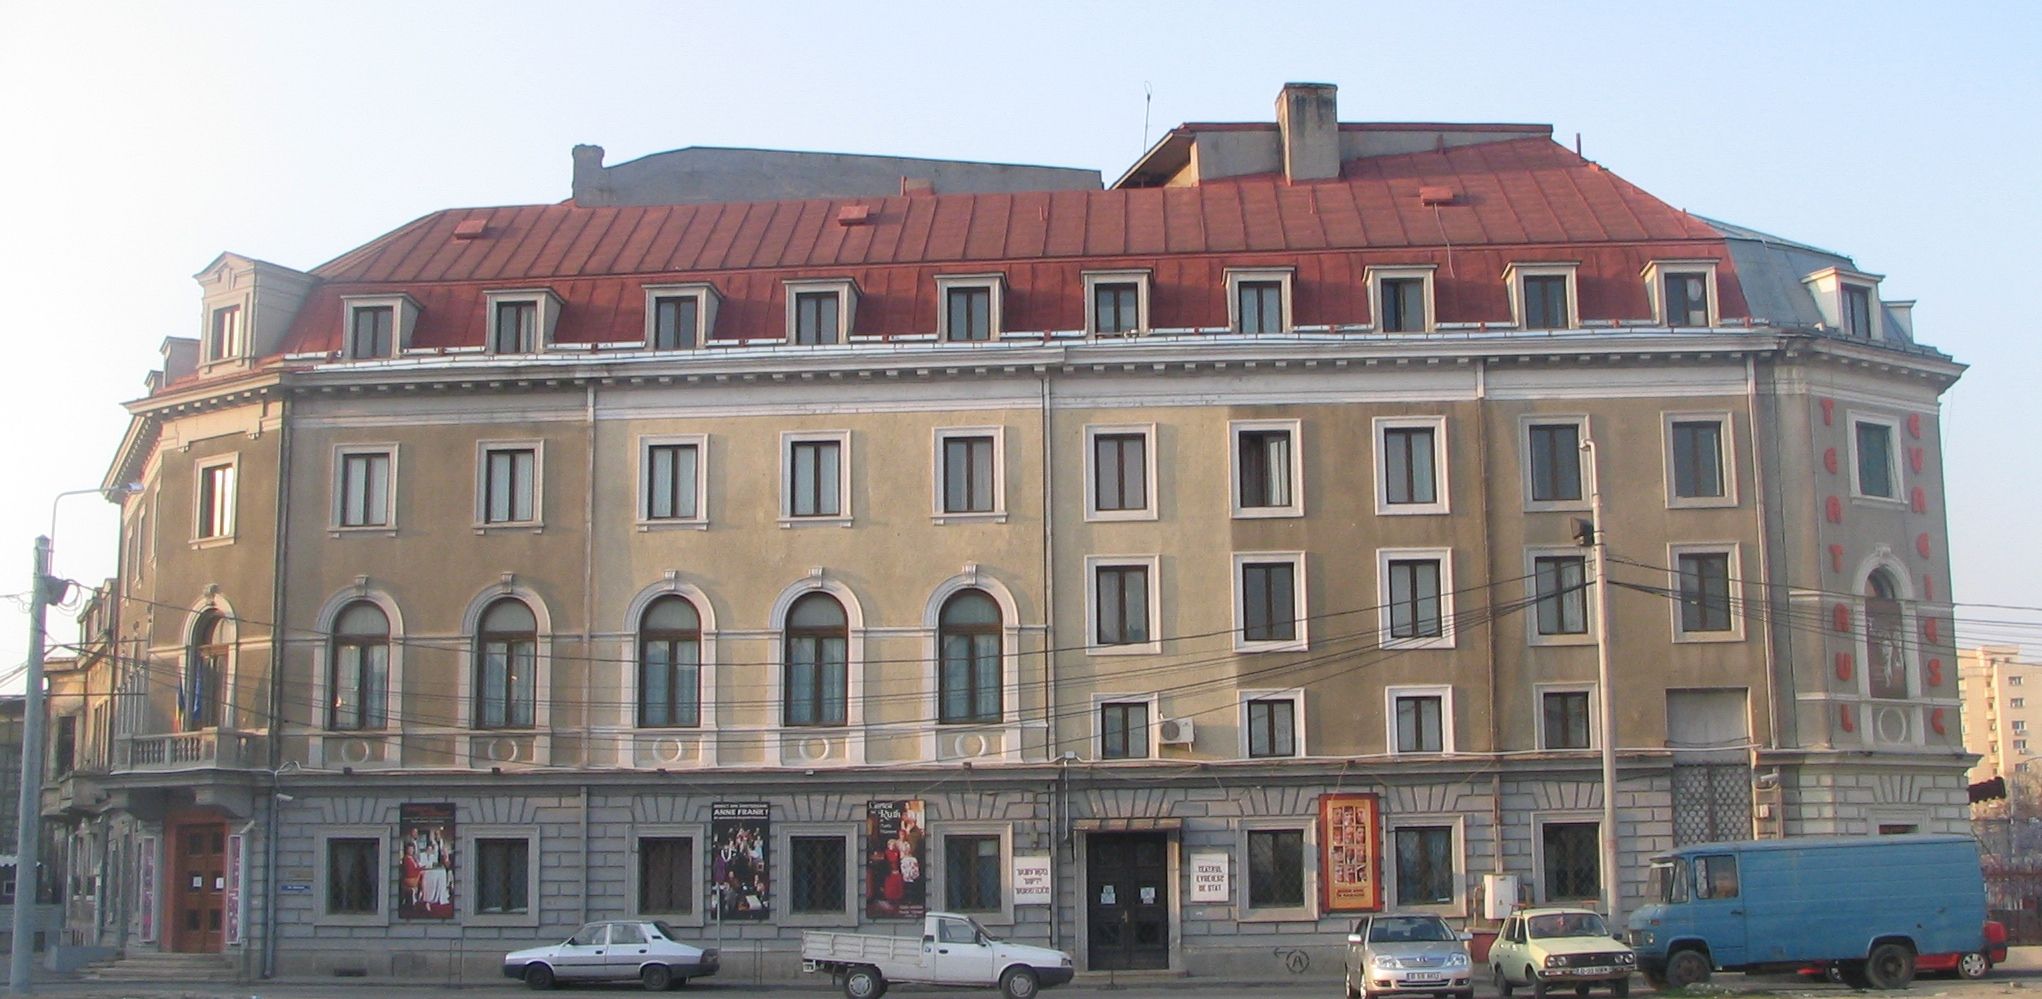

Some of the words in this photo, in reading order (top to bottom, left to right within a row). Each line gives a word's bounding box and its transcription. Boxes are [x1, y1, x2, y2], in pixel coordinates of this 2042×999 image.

[1820, 399, 1855, 733] TEATRUL
[1907, 412, 1946, 735] EVREIESC
[713, 808, 737, 816] ANNE
